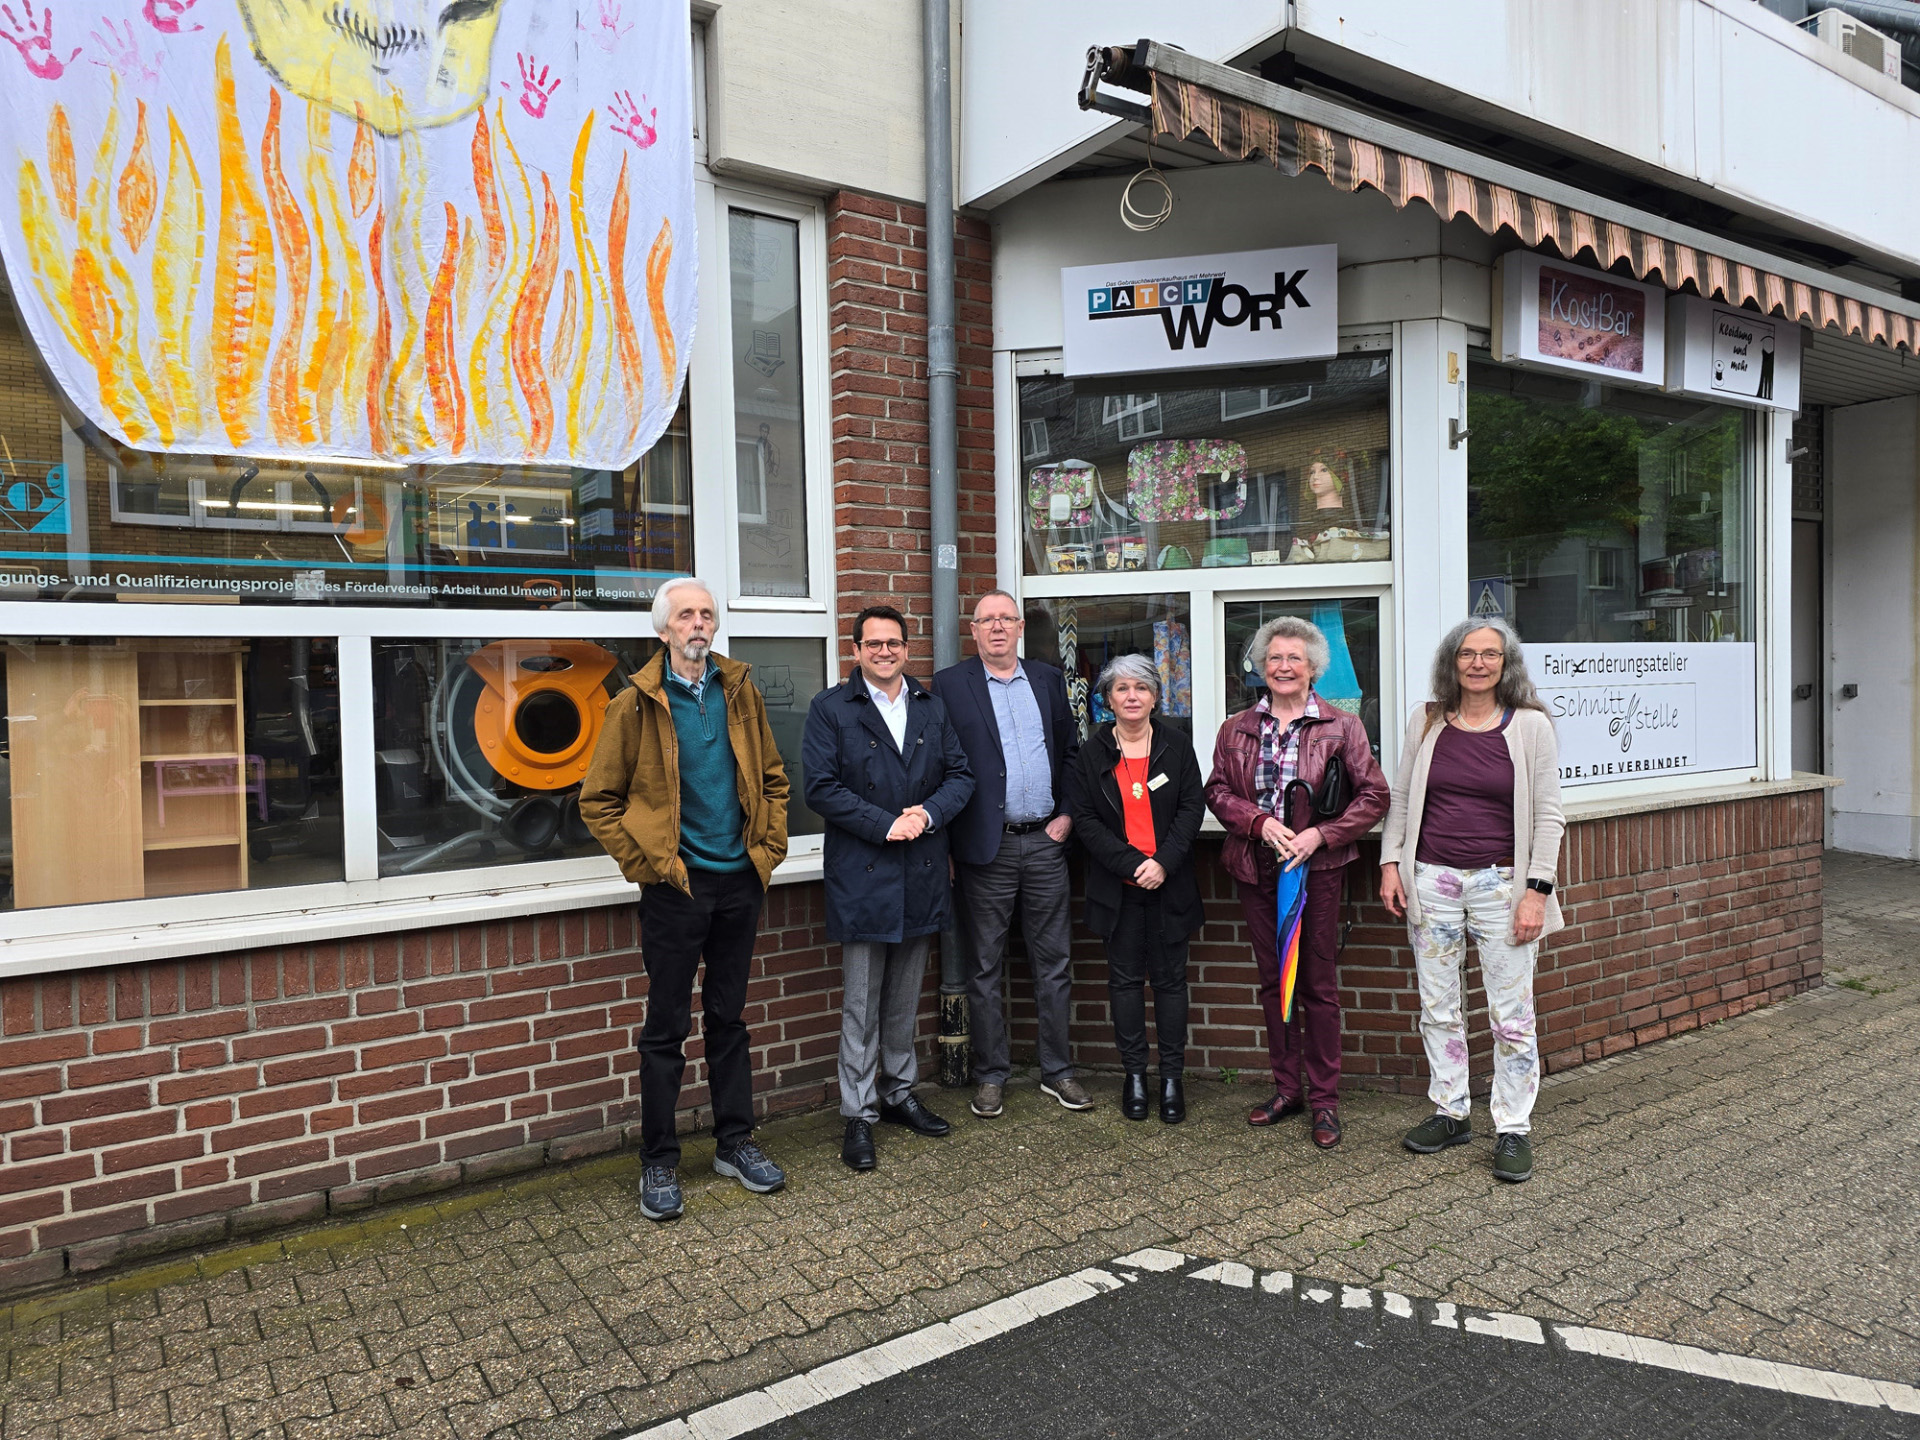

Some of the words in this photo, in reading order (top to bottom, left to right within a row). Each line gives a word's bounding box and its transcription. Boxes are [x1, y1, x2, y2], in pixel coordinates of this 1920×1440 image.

[1188, 272, 1198, 280] mit
[1550, 278, 1635, 337] KostBar
[1718, 322, 1753, 344] Kleidung
[1733, 344, 1748, 356] und
[1730, 360, 1748, 372] mehr
[74, 574, 110, 586] und
[116, 573, 310, 593] Qualifizierungsprojekt
[315, 580, 341, 592] des
[345, 581, 439, 595] Fördervereins
[441, 584, 481, 595] Arbeit
[484, 585, 508, 596] und
[511, 585, 557, 597] Umwelt
[560, 586, 571, 597] in
[573, 587, 593, 597] der
[596, 588, 635, 599] Region
[1592, 763, 1613, 776] DIE
[1618, 756, 1688, 774] VERBINDET
